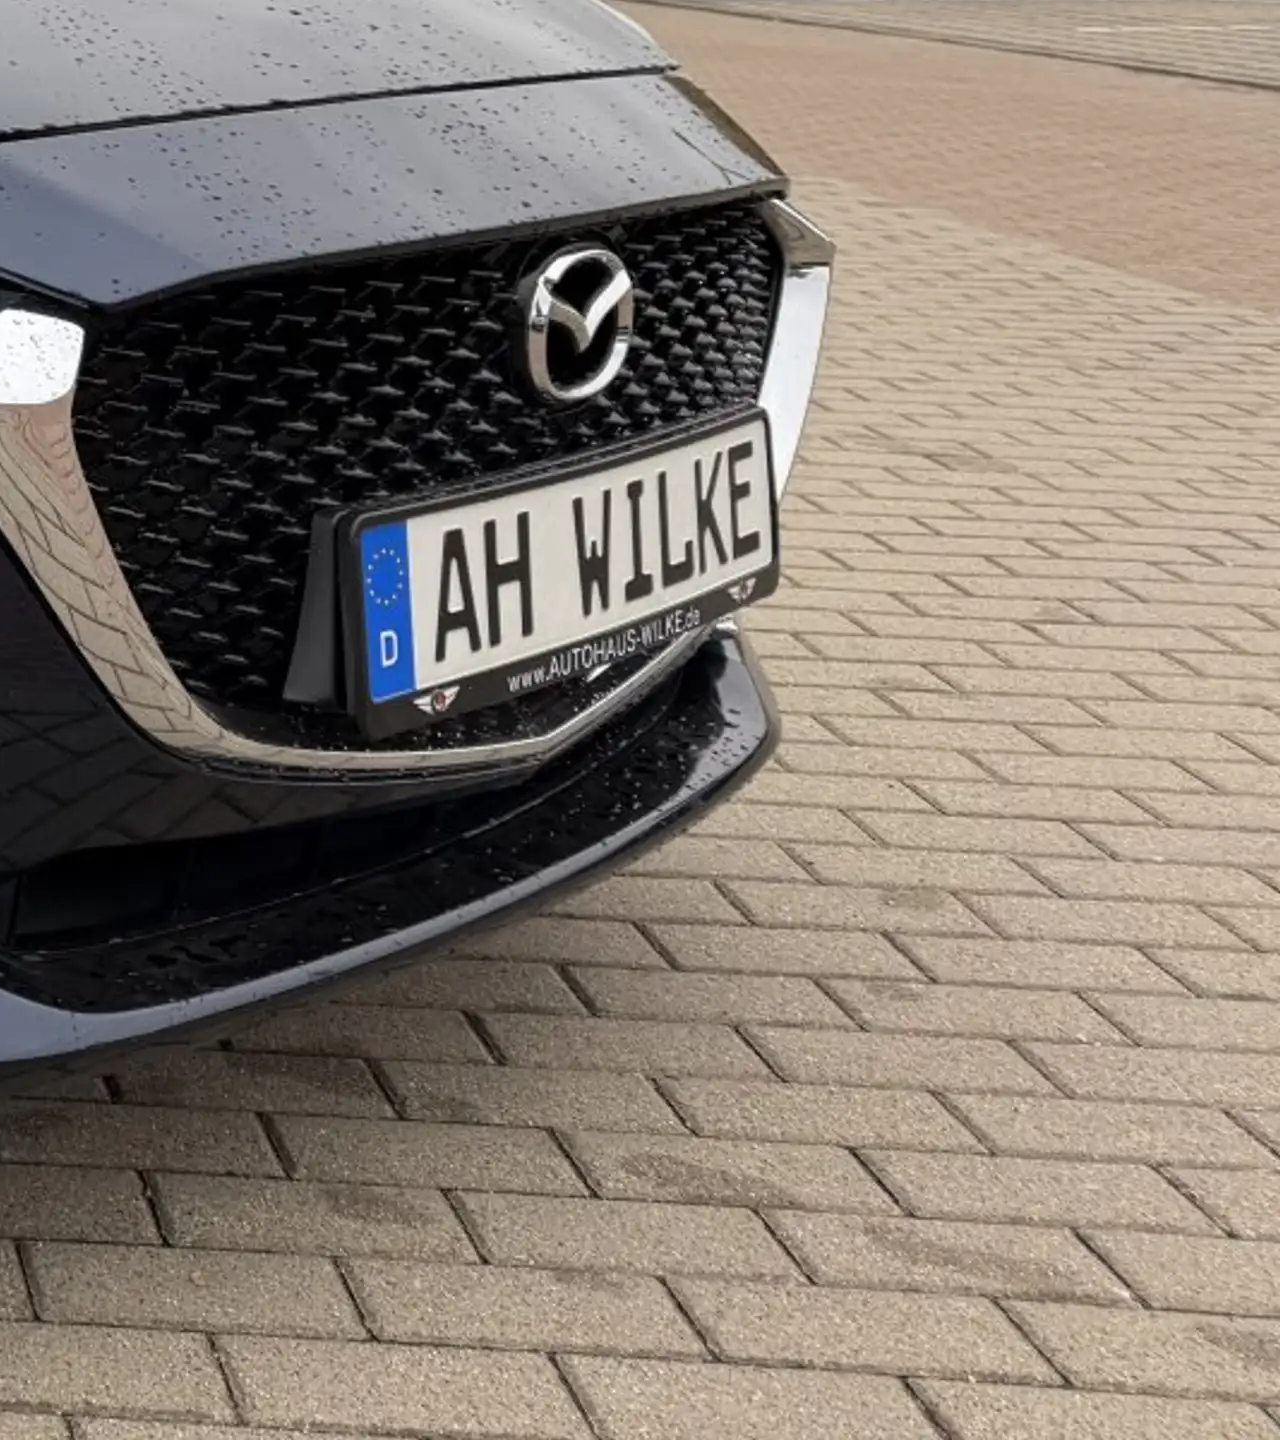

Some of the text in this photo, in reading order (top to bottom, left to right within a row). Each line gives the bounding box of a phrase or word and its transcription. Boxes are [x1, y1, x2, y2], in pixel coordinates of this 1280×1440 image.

[435, 440, 761, 664] AH WILKE
[379, 630, 399, 669] D
[507, 606, 701, 693] www.AUTOHAUS-WILKE.de
